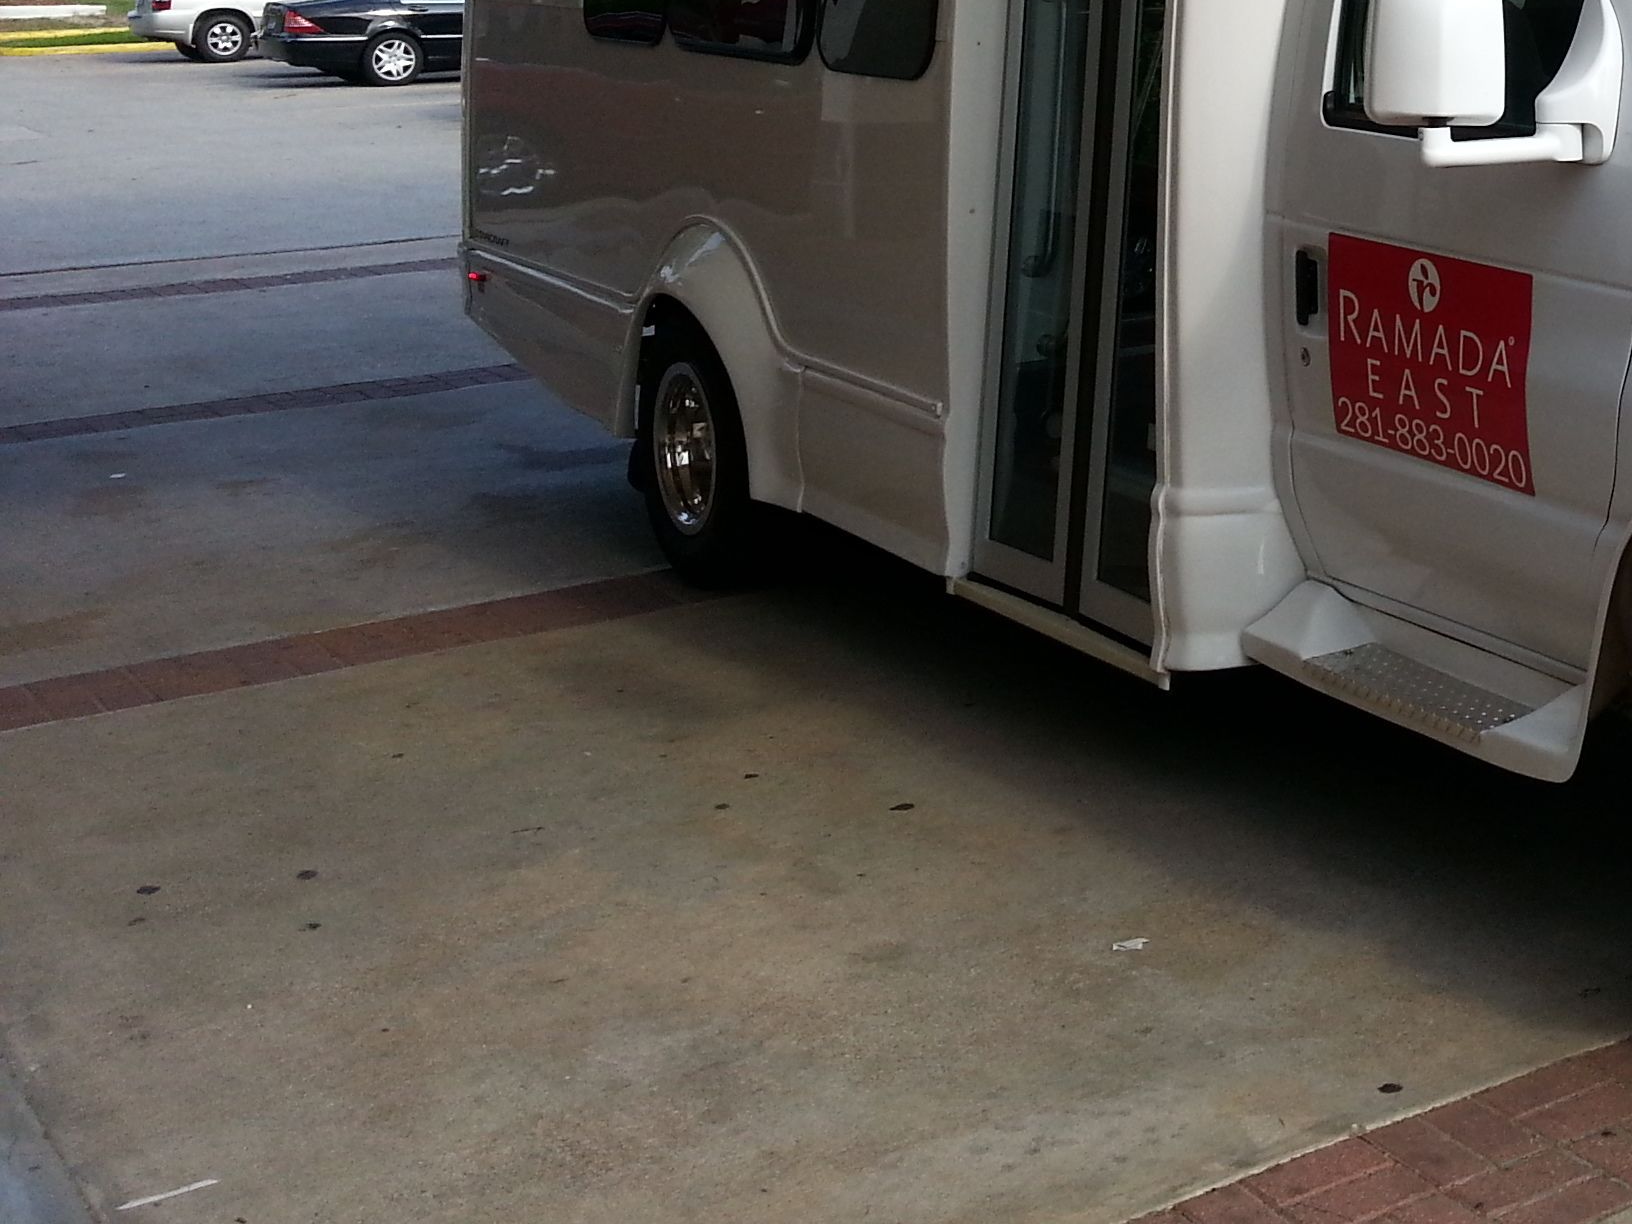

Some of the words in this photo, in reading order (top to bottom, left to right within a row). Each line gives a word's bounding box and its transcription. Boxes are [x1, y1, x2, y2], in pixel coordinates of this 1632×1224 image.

[1339, 288, 1512, 388] RAMADA
[1367, 358, 1484, 428] EAST
[1338, 396, 1526, 488] 281-883-0020
